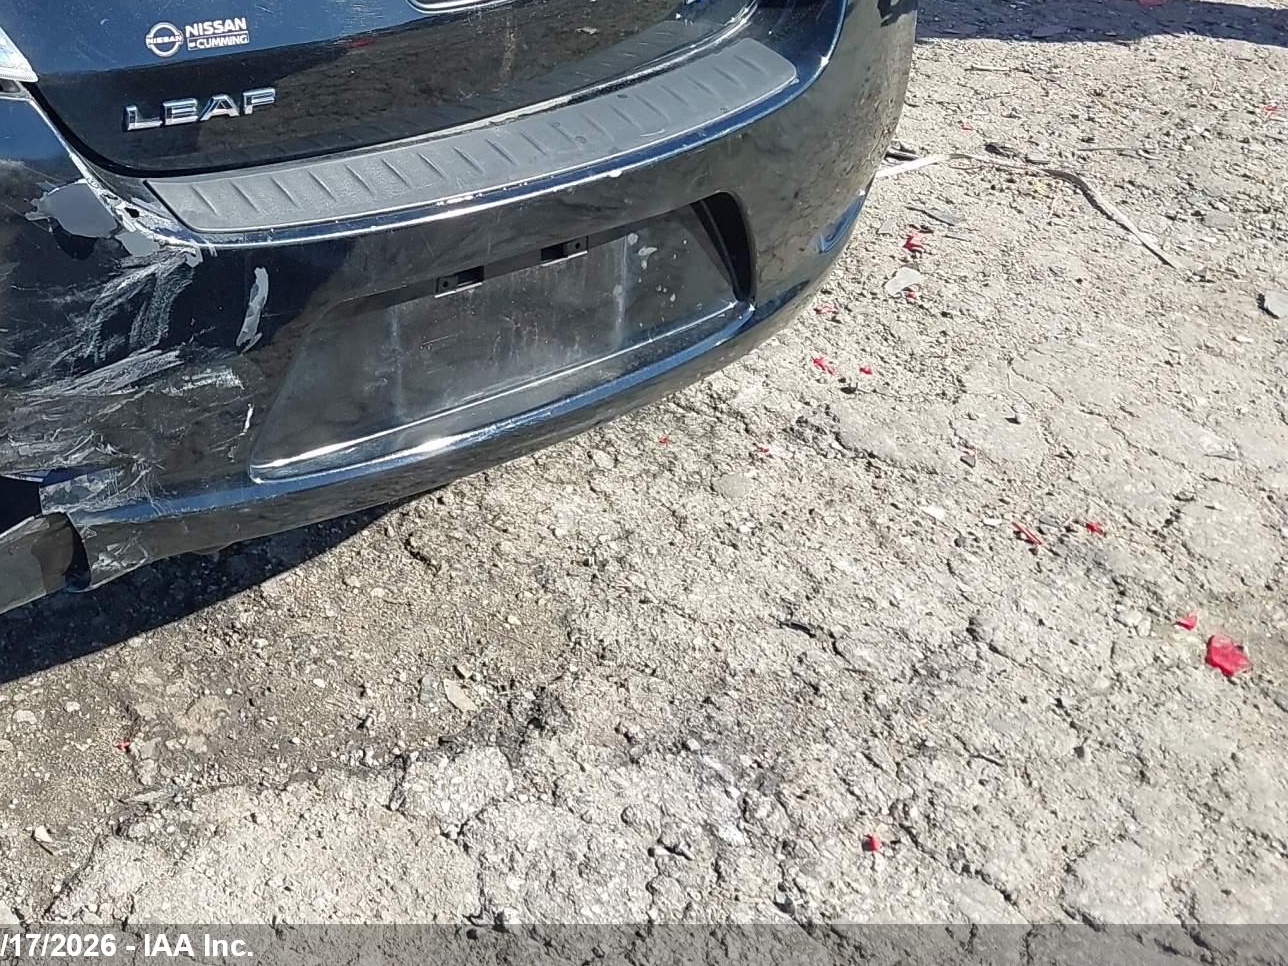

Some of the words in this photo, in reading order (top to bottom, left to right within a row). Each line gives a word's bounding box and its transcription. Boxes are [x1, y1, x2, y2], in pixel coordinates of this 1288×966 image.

[185, 17, 247, 38] NISSAN
[196, 34, 249, 49] CUMMING
[122, 87, 277, 131] LEAF
